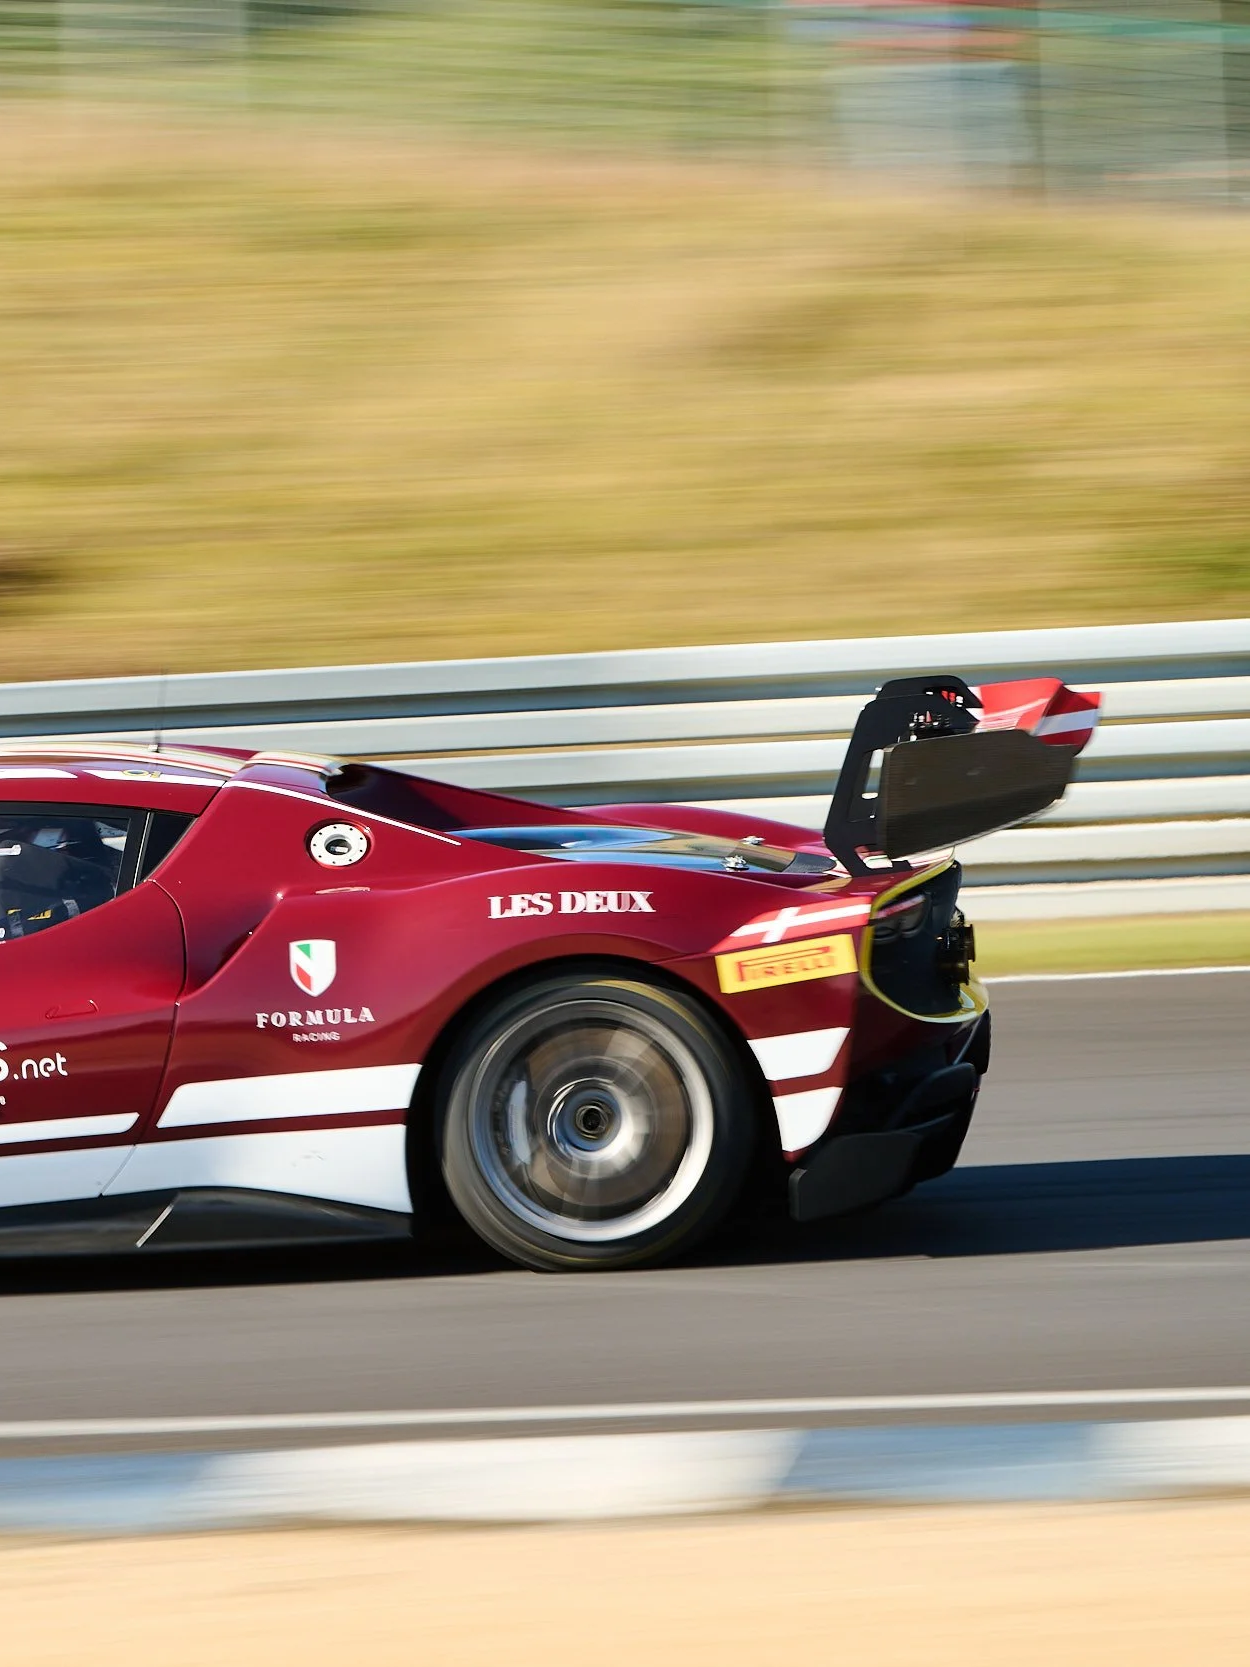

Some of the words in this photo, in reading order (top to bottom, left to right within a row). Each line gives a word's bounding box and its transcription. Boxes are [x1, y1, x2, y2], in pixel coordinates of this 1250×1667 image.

[487, 892, 553, 919] LES
[558, 891, 657, 913] DEUX
[255, 1006, 375, 1029] FORMULA
[292, 1031, 340, 1042] RACING
